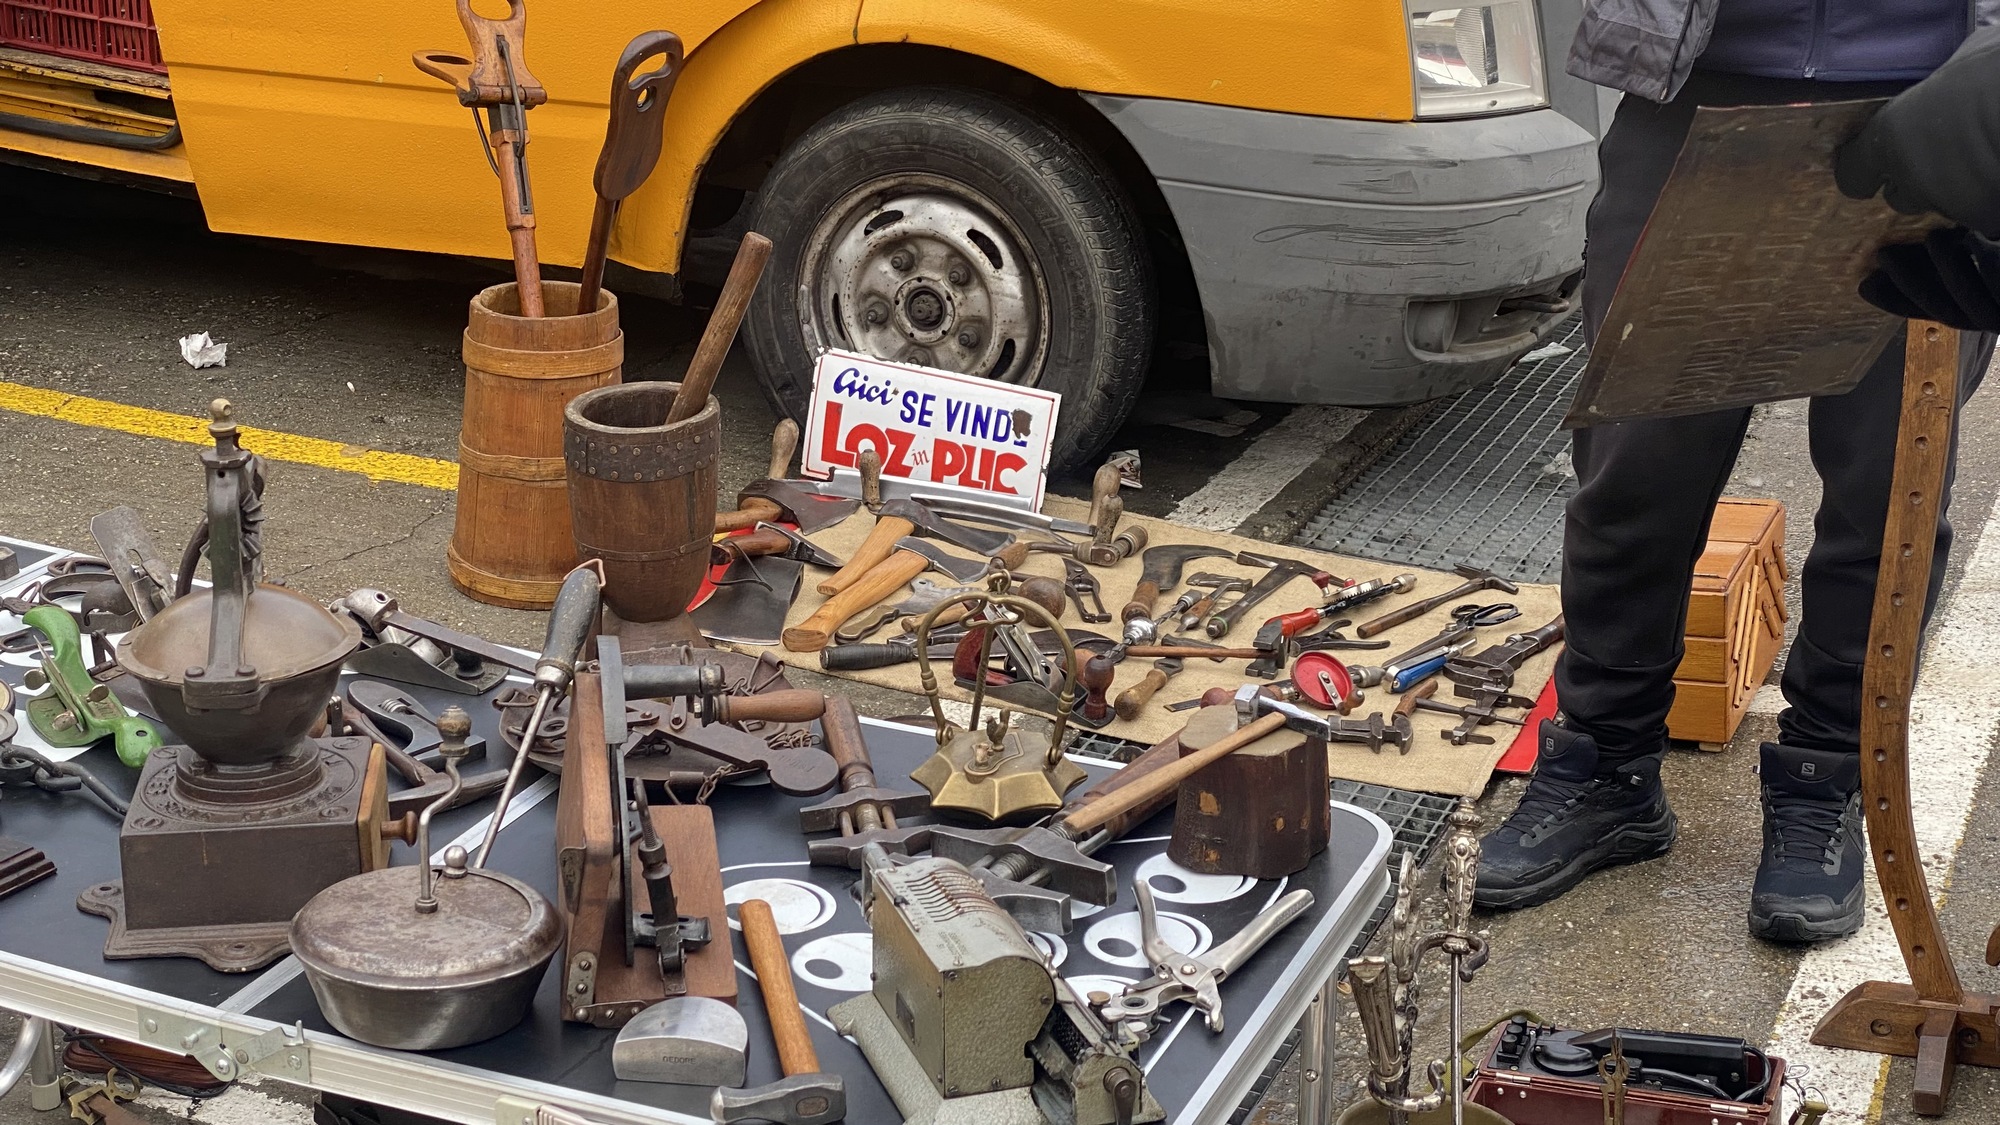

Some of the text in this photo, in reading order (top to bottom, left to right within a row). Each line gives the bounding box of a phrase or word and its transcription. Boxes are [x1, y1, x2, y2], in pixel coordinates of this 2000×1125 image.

[820, 400, 1028, 495] LOZ in PLIC
[833, 368, 1029, 447] Aici SE VIND
